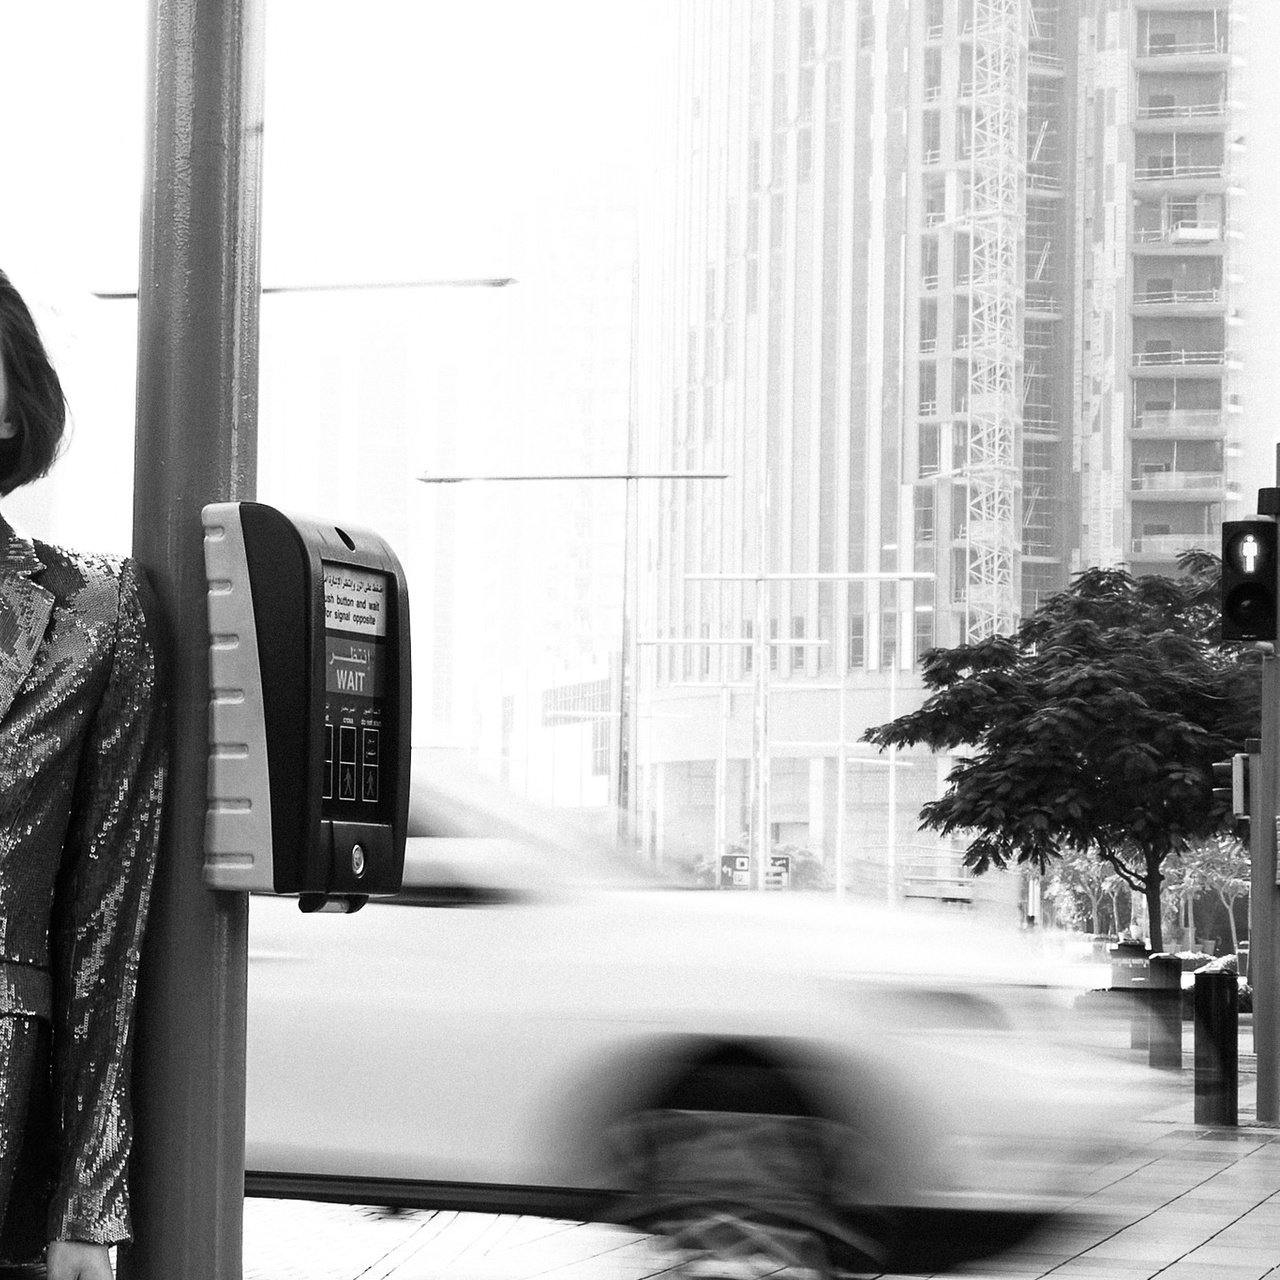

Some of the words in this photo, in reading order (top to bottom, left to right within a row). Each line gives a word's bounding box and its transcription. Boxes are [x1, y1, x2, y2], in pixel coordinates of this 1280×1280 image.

[337, 595, 354, 606] button
[357, 600, 366, 609] and
[369, 601, 379, 611] wait
[335, 610, 350, 622] signal
[353, 614, 376, 625] opposite
[337, 669, 365, 691] WAIT
